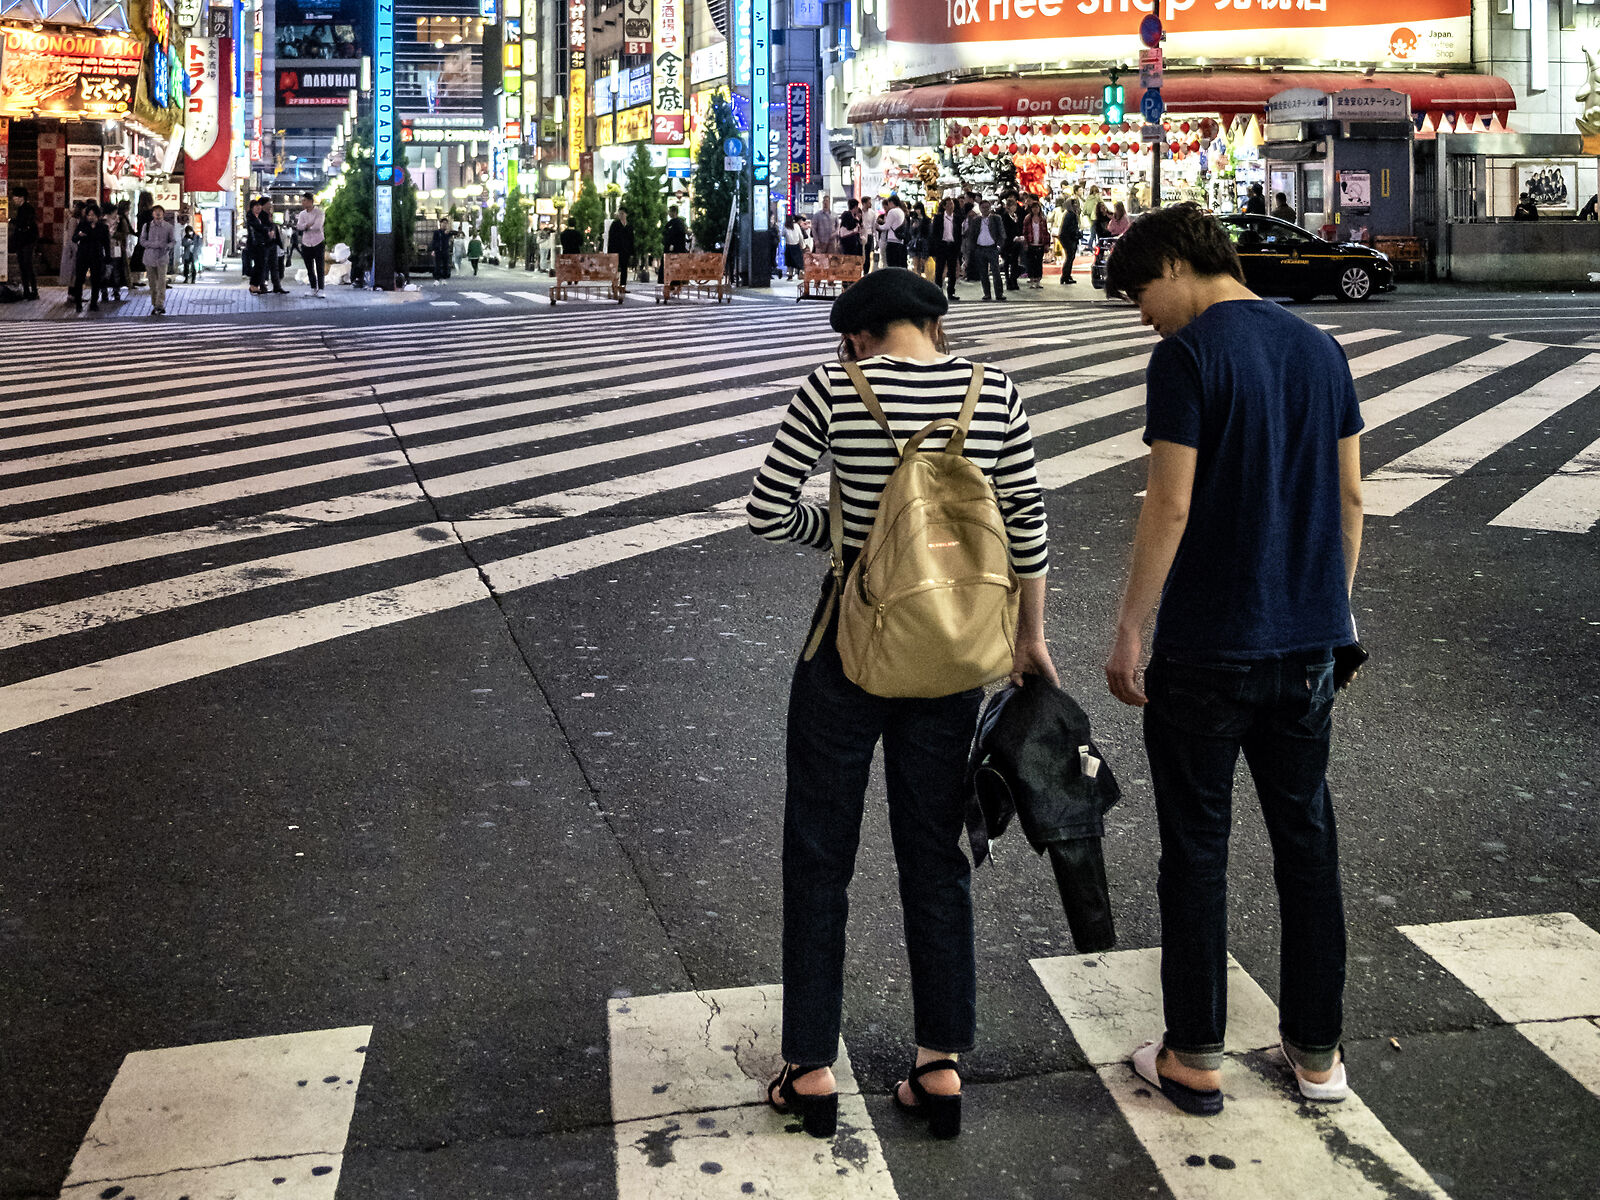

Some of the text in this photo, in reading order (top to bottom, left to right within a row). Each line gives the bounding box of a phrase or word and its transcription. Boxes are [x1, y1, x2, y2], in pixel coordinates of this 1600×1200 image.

[7, 31, 142, 58] OKONOMI YAKI
[629, 43, 647, 54] B1
[189, 44, 205, 113] トラノコ
[303, 74, 357, 87] MARUHAN
[656, 51, 683, 111] 金の蔵
[1016, 96, 1103, 112] Don Quijo
[1337, 96, 1402, 107] 安全安心ステーション
[379, 88, 391, 144] ROAD
[655, 116, 675, 134] 2F
[790, 87, 807, 159] カラオケ
[791, 162, 806, 174] B1
